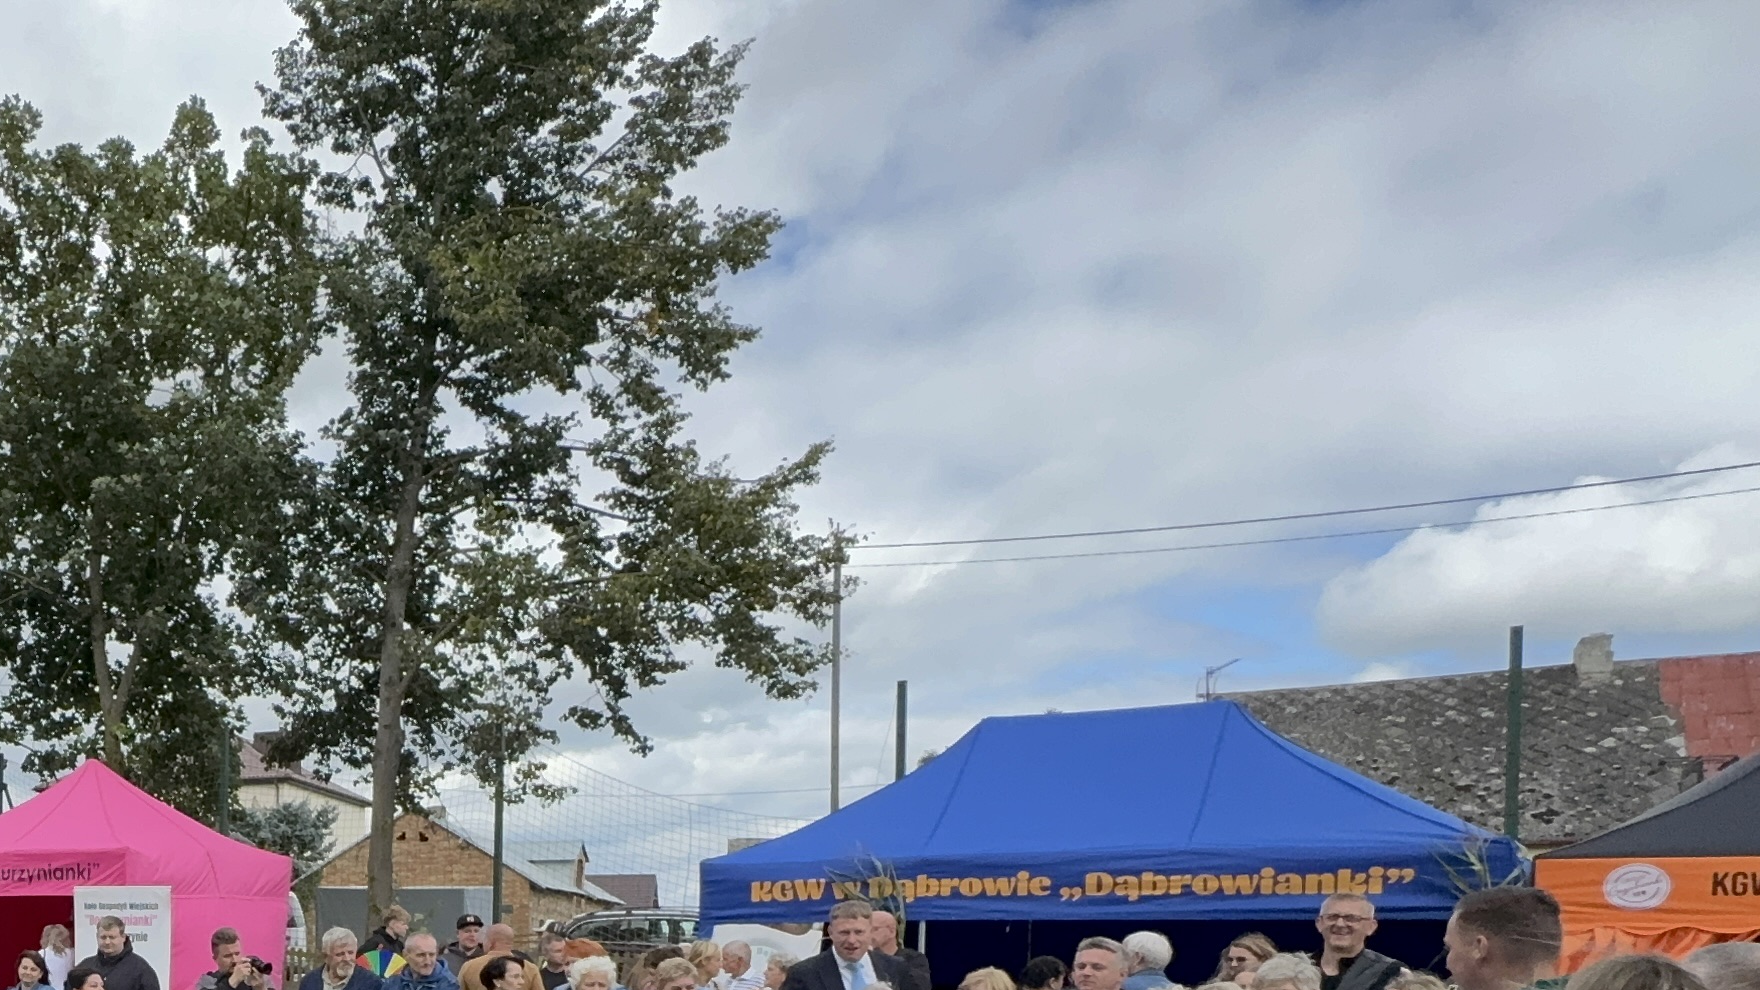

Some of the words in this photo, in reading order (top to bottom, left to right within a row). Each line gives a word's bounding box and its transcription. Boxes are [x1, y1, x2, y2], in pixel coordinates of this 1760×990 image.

[751, 878, 826, 902] KGW
[869, 870, 1051, 902] Dąbrowie
[1059, 867, 1415, 901] „Dąbrowianki”
